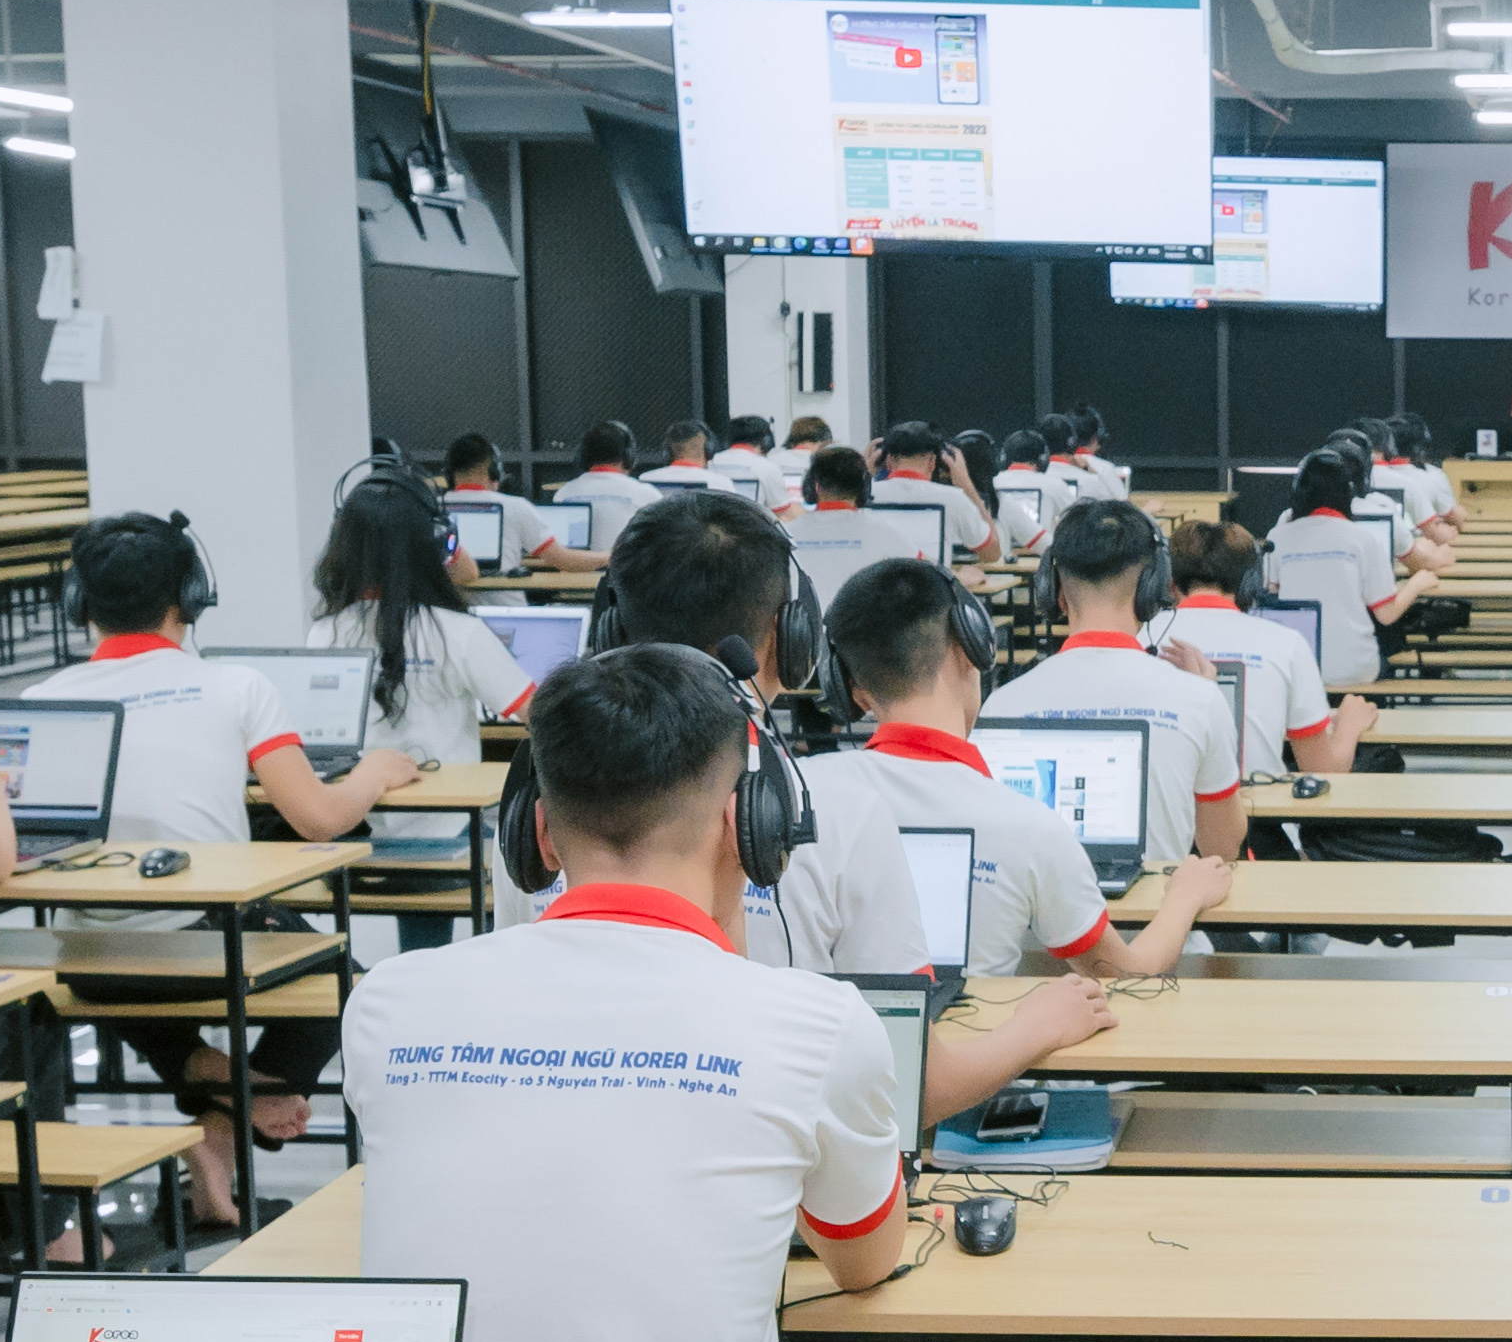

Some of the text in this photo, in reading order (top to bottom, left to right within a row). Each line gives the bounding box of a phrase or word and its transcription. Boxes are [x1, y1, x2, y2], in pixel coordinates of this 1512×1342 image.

[962, 124, 987, 136] 2023
[388, 1045, 444, 1065] TRUNG
[451, 1042, 495, 1064] TÂM
[621, 1050, 688, 1070] KOREA
[695, 1053, 742, 1077] LINK
[428, 1071, 458, 1083] TTTM
[461, 1071, 508, 1087] Ecocity
[636, 1076, 666, 1090] Vinh
[717, 1083, 737, 1097] An
